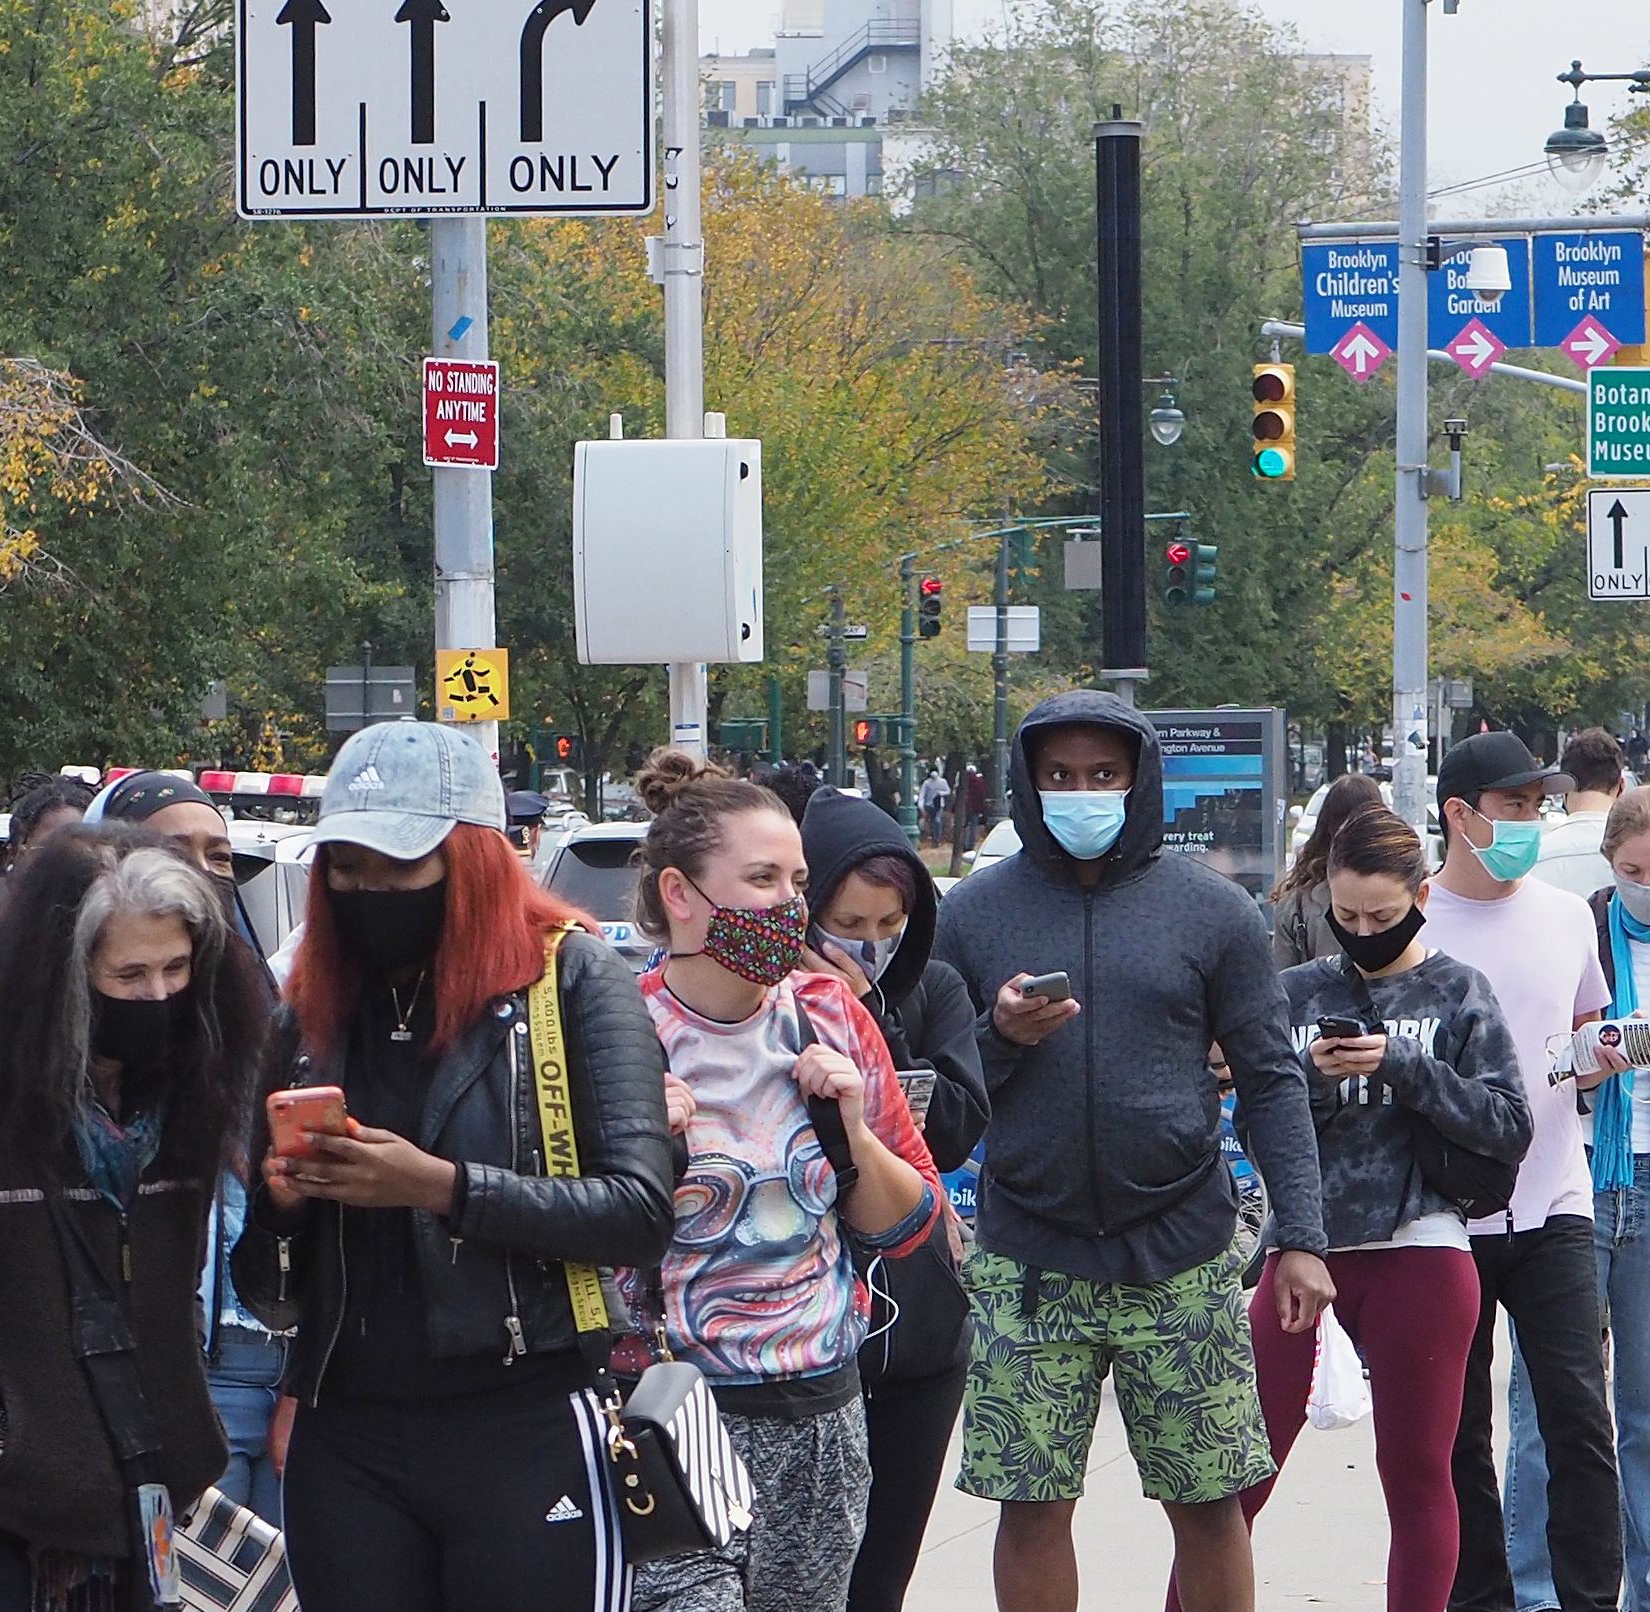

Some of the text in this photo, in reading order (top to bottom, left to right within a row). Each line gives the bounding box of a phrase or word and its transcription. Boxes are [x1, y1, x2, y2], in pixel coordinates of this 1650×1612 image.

[260, 157, 346, 195] ONLY
[379, 156, 467, 194] ONLY
[509, 154, 619, 192] ONLY
[1328, 250, 1387, 271] Brooklyn
[1556, 241, 1621, 265] Brooklyn
[1316, 273, 1400, 296] Children's
[1558, 268, 1619, 287] Museum
[1331, 301, 1387, 317] Museum
[1569, 292, 1611, 311] of Art
[429, 370, 493, 395] NO STANDING
[436, 400, 486, 422] ANYTIME
[1594, 574, 1642, 590] ONLY
[1170, 728, 1212, 739] Parkway
[1213, 728, 1221, 737] &
[1189, 743, 1225, 752] Avenue
[1188, 831, 1214, 840] treat
[950, 1187, 977, 1207] bik
[546, 1510, 583, 1521] adidas
